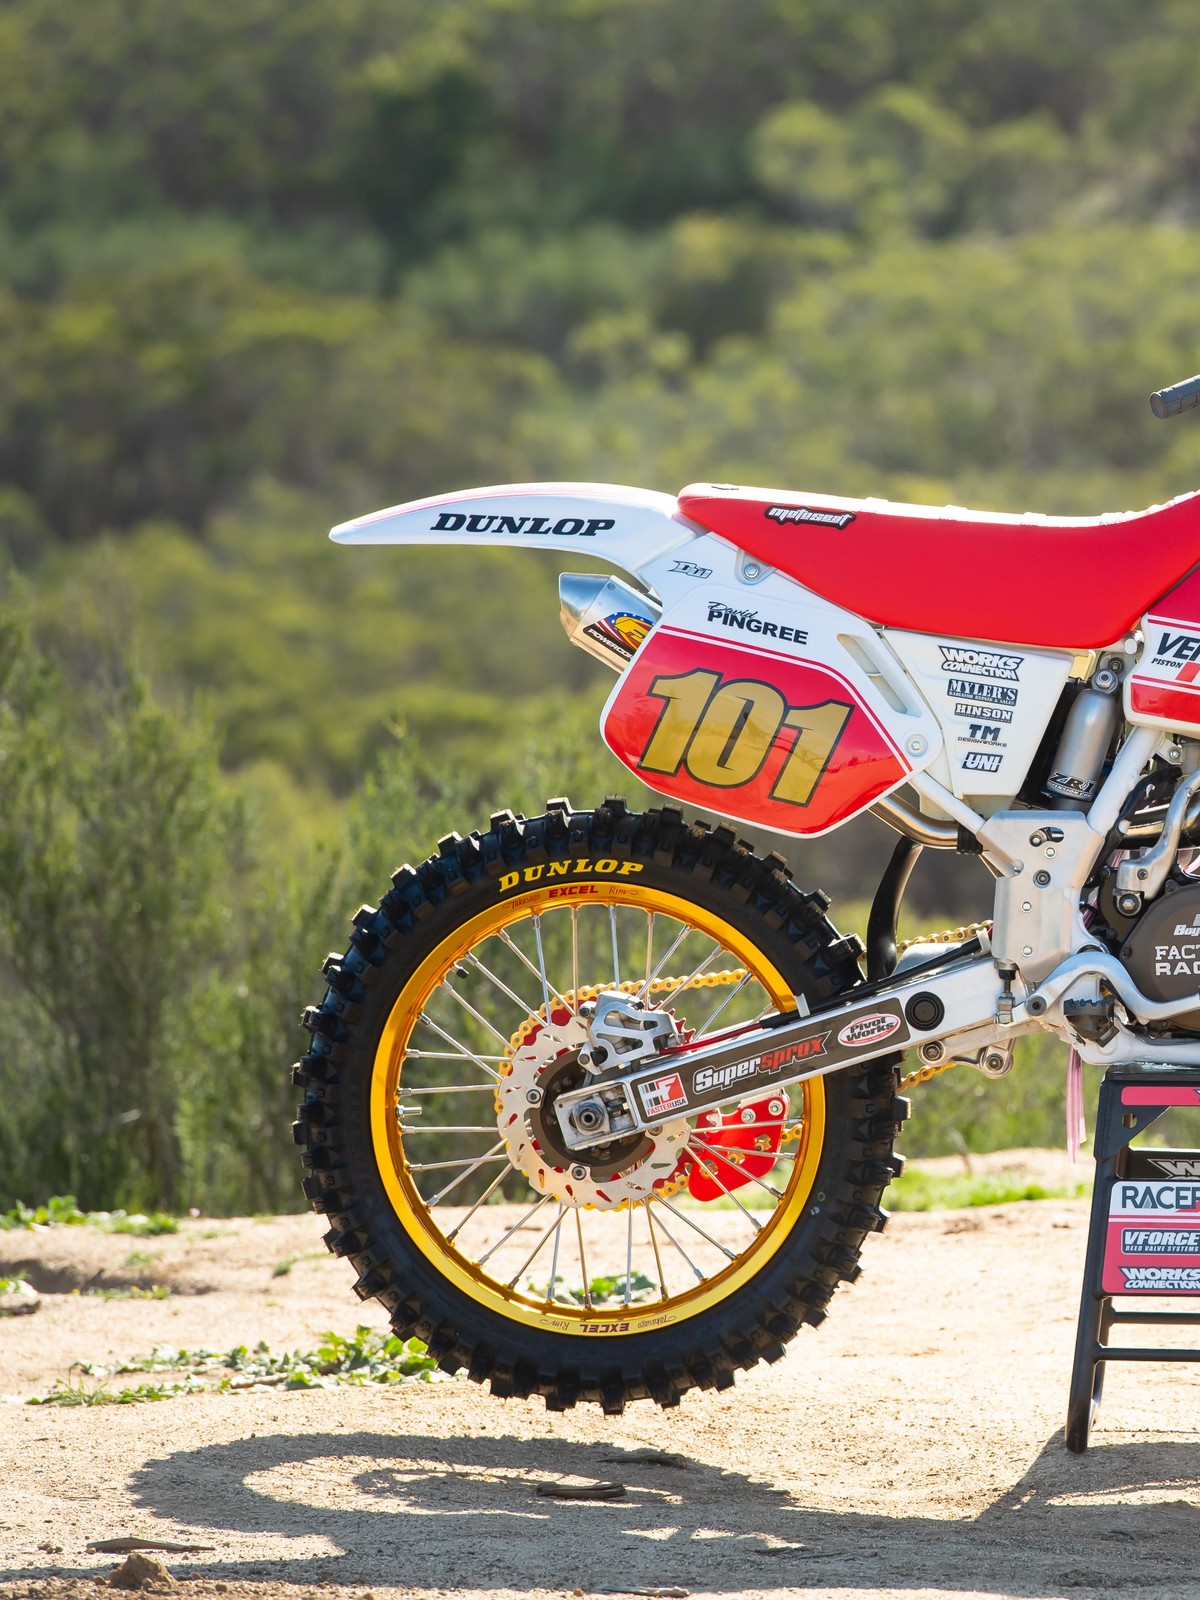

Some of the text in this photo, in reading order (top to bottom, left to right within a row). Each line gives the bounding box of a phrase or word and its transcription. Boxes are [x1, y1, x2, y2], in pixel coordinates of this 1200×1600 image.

[430, 512, 616, 537] DUNLOP
[708, 601, 758, 619] David
[707, 609, 809, 645] PINGREE
[588, 628, 634, 658] POWERCOR
[940, 647, 1023, 669] WORKS
[1151, 658, 1184, 669] PISTON
[942, 661, 1018, 680] CONNECTION
[950, 680, 1016, 701] MYLER'S
[955, 704, 1012, 720] HINSON
[636, 667, 855, 808] 101
[969, 724, 1001, 741] TM
[498, 858, 644, 893] DUNLOP
[548, 885, 599, 899] EXCEL
[846, 1022, 895, 1042] Works
[850, 1016, 886, 1033] Pivot
[694, 1036, 826, 1092] Supersprox
[1124, 1231, 1200, 1247] VFORCE
[580, 1323, 630, 1334] EXCEL
